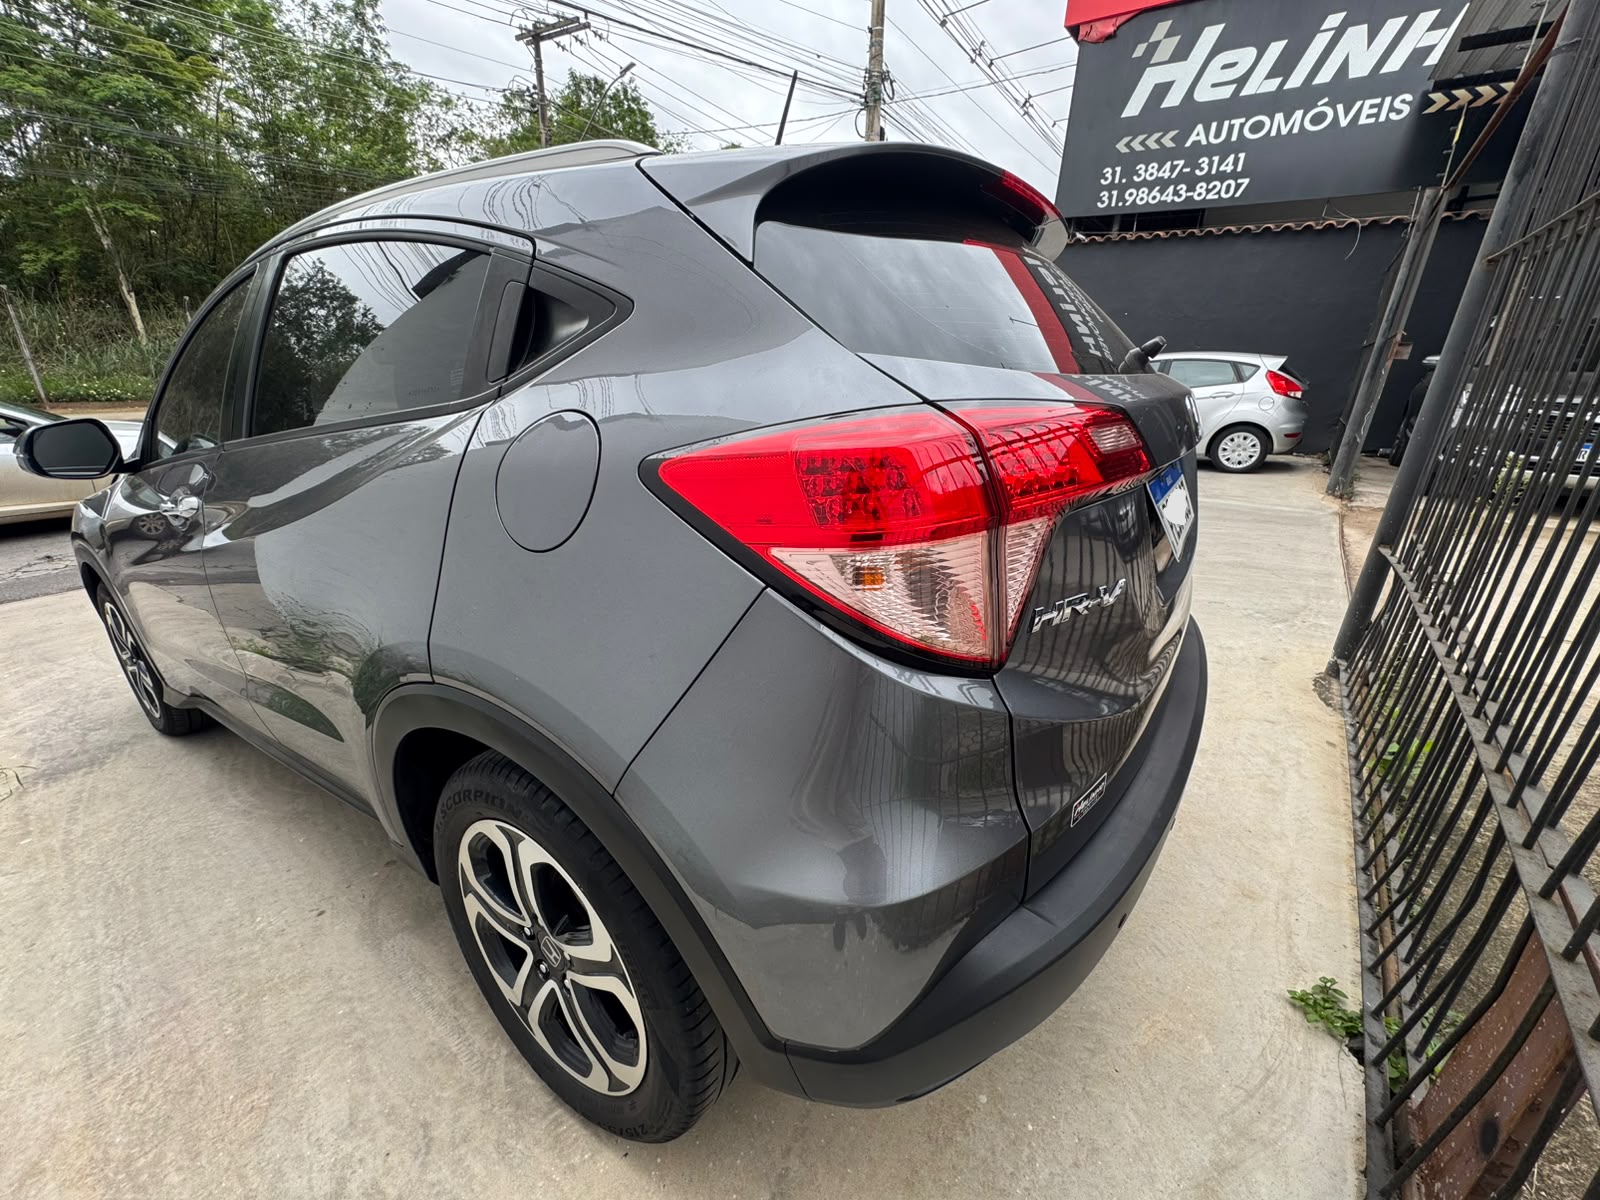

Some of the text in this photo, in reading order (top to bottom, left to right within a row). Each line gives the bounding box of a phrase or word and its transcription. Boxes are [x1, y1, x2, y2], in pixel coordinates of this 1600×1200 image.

[1185, 93, 1414, 147] AUTOMÓVEIS
[1096, 177, 1250, 208] 31.98643-8207
[1027, 578, 1127, 633] HR-V
